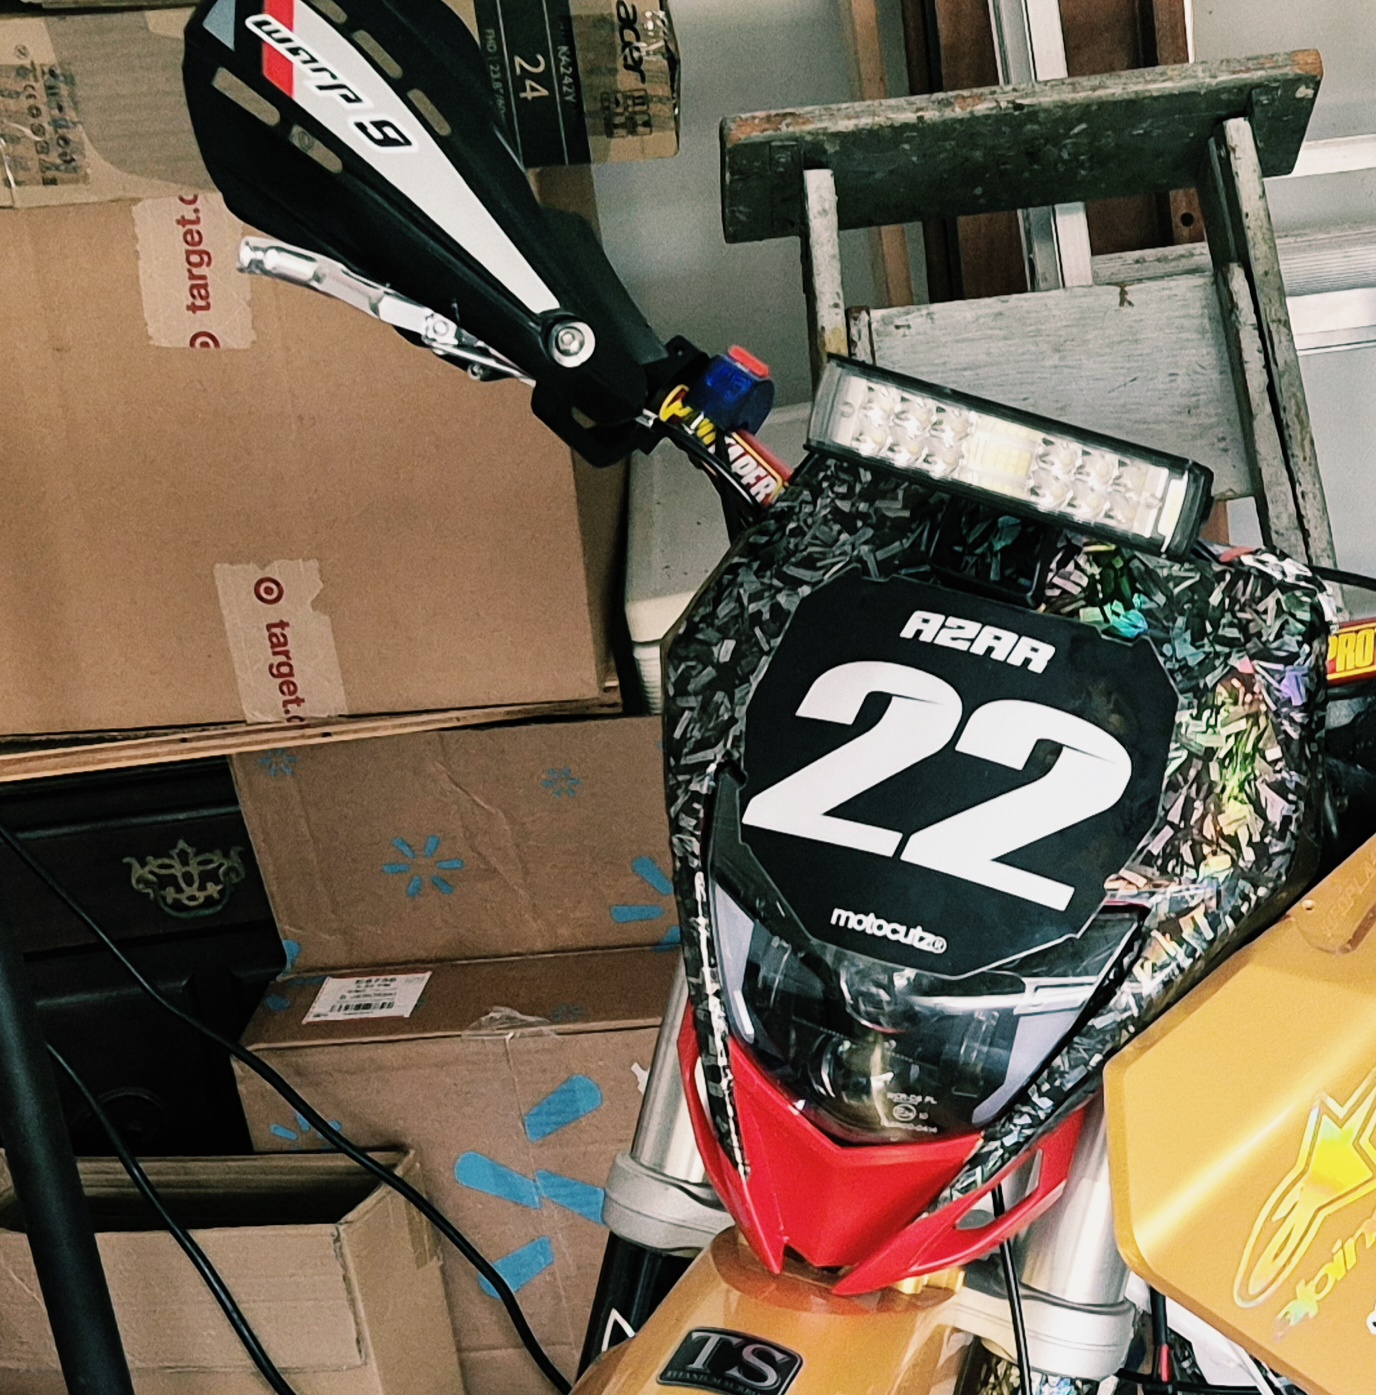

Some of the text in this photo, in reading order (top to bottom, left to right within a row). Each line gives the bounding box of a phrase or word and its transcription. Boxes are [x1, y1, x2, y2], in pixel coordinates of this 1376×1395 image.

[513, 53, 550, 101] 24
[616, 0, 647, 84] acer
[742, 660, 1133, 912] 22
[686, 1331, 791, 1390] TS
